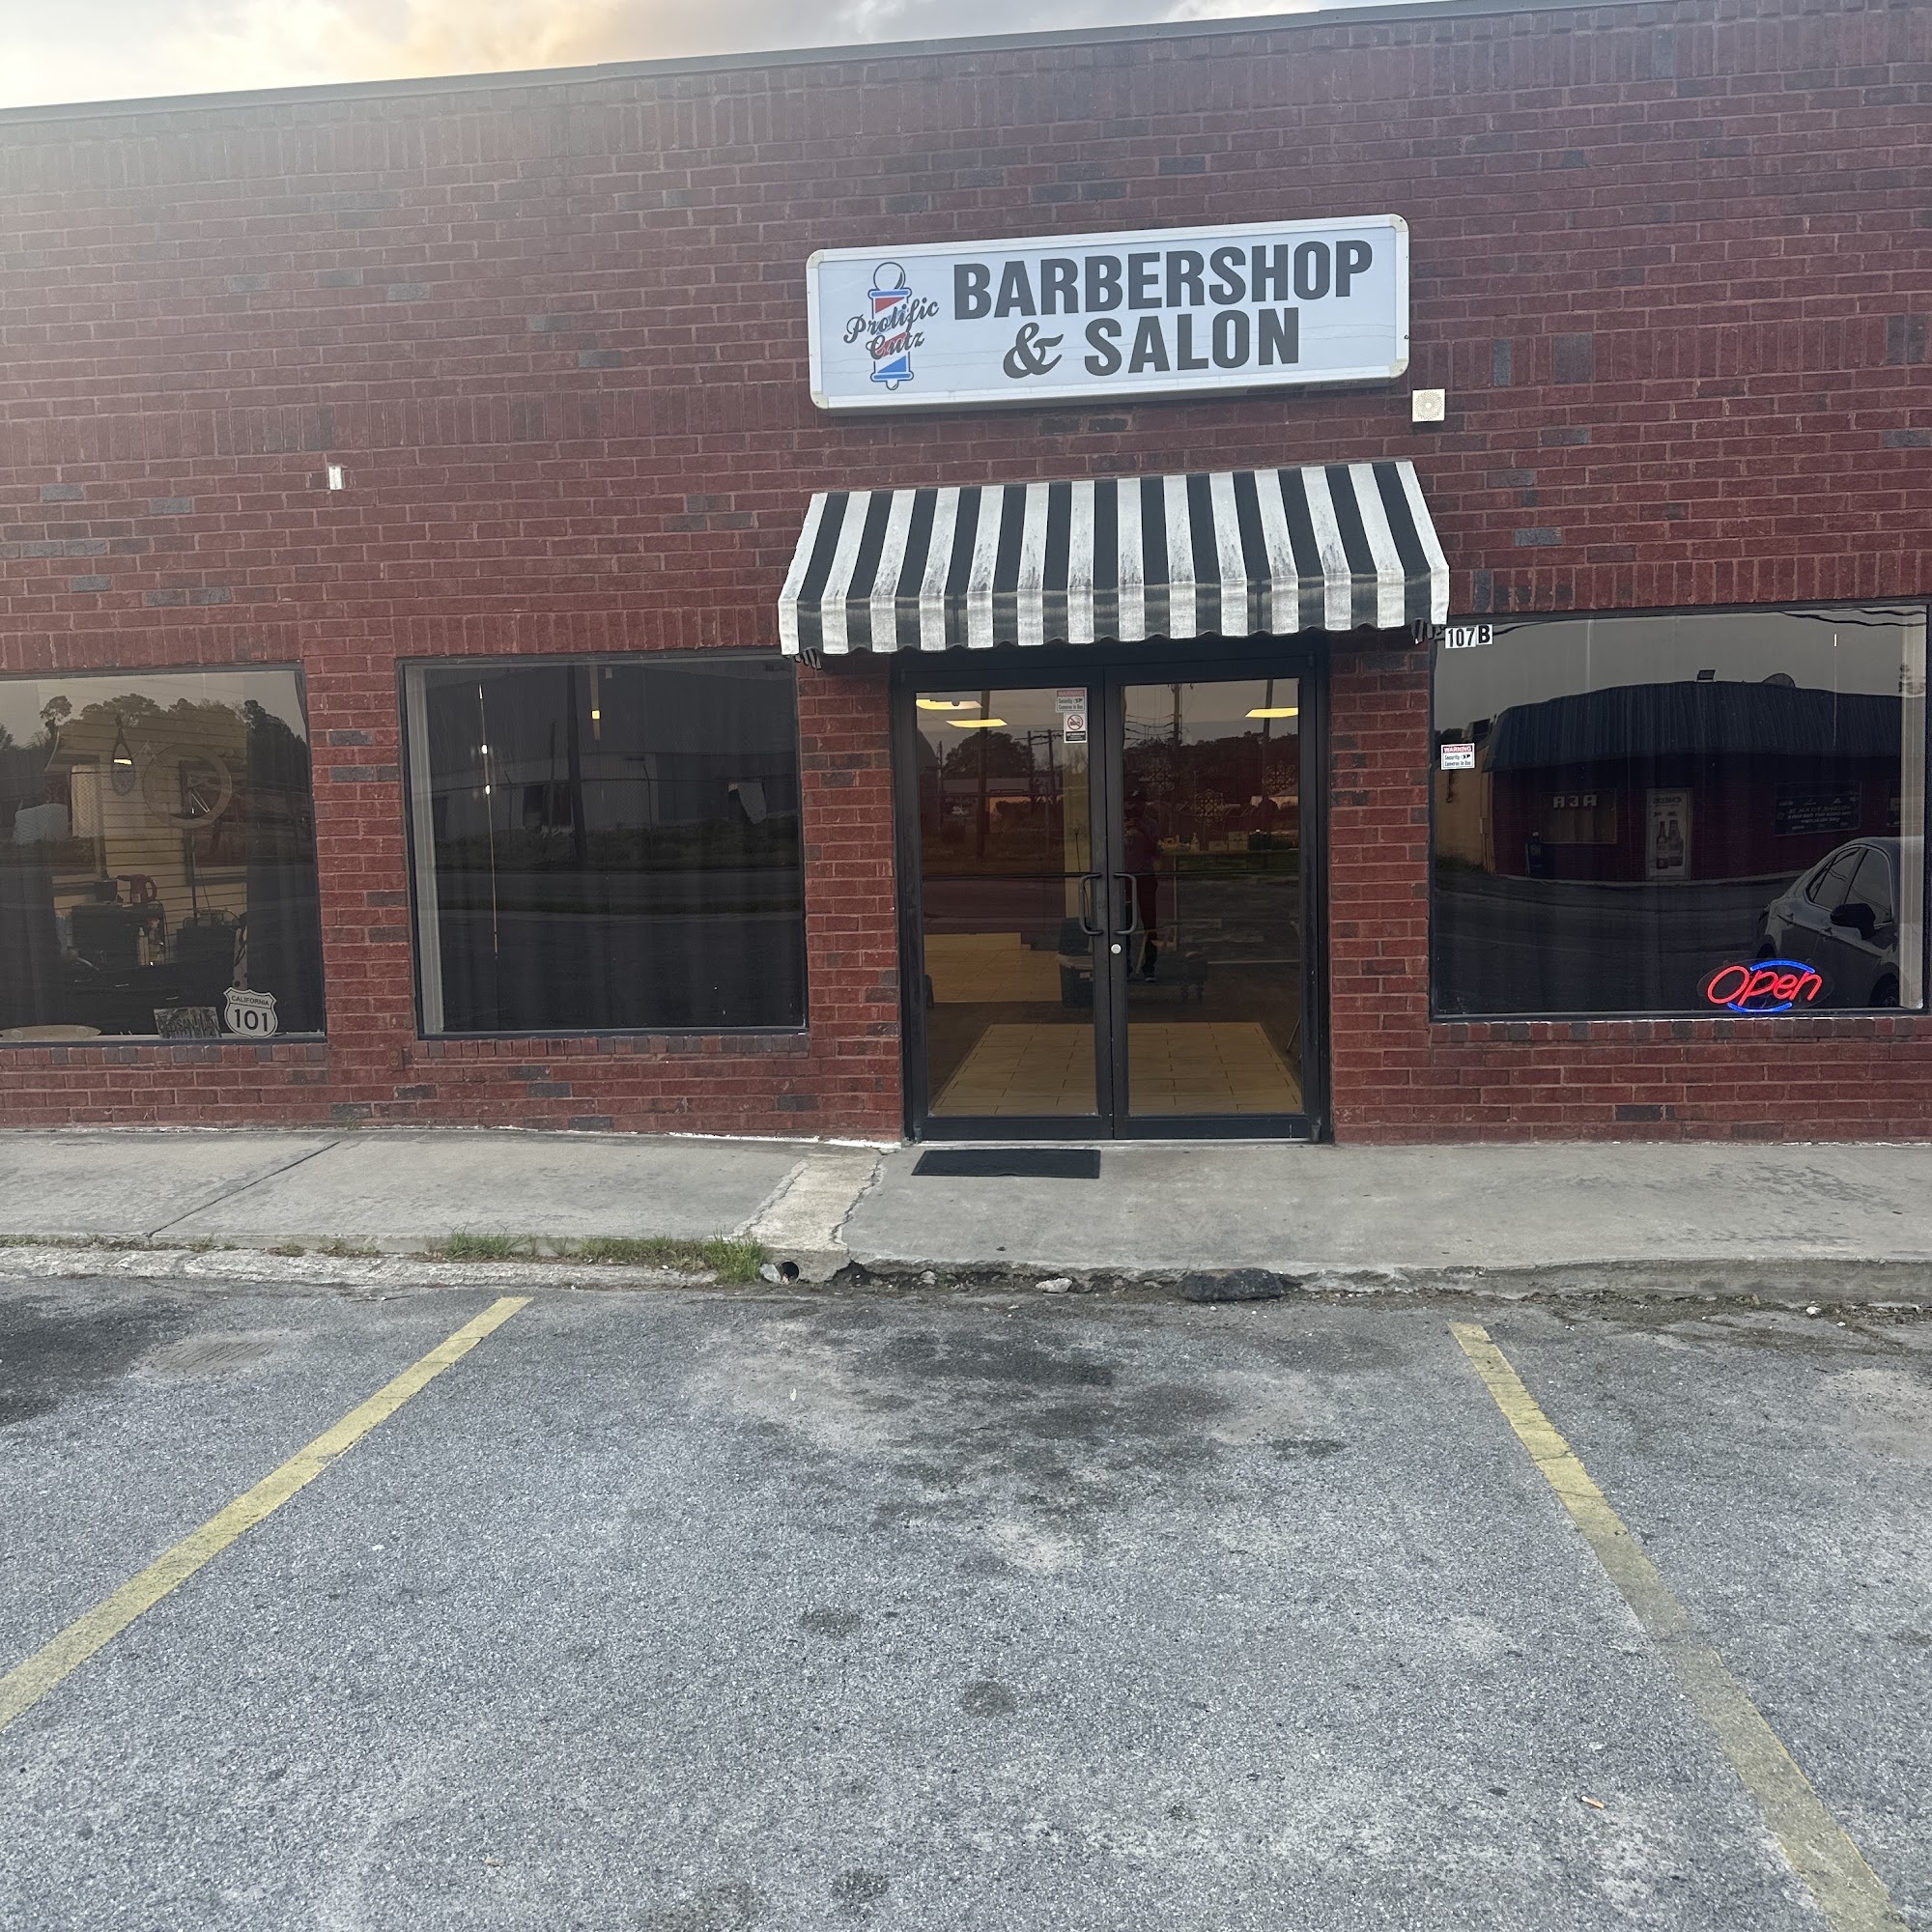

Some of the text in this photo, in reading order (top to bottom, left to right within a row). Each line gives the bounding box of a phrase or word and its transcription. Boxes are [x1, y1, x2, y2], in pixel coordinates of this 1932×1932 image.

[953, 240, 1373, 320] BARBERSHOP
[843, 297, 939, 344] Prolific
[866, 330, 924, 360] Cutz
[1003, 307, 1299, 379] & SALON
[1448, 625, 1491, 648] 107B
[231, 995, 270, 1006] CALIFORNIA
[1707, 966, 1822, 1007] Open
[235, 1009, 268, 1032] 101
